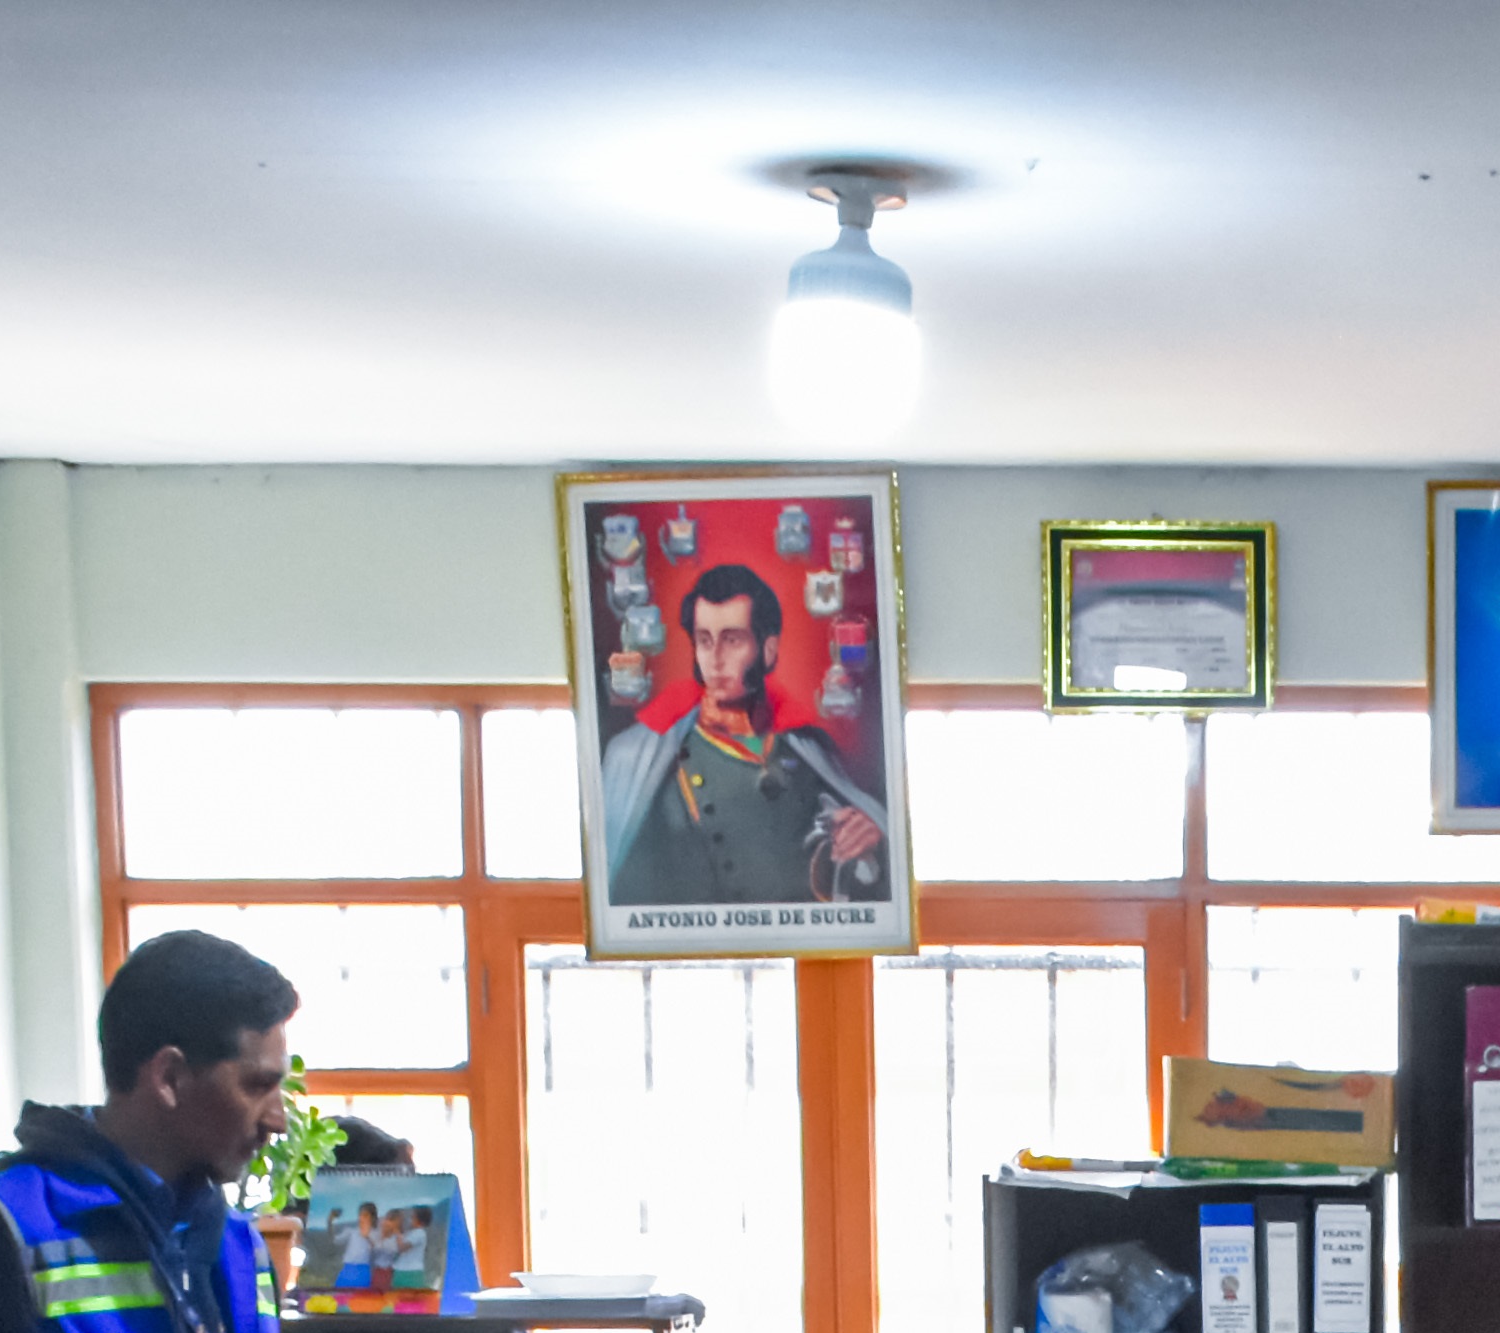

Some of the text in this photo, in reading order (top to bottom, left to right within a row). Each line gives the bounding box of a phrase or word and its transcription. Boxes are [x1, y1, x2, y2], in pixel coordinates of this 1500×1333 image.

[628, 906, 876, 930] ANTONIO JOSE DE SUCRE
